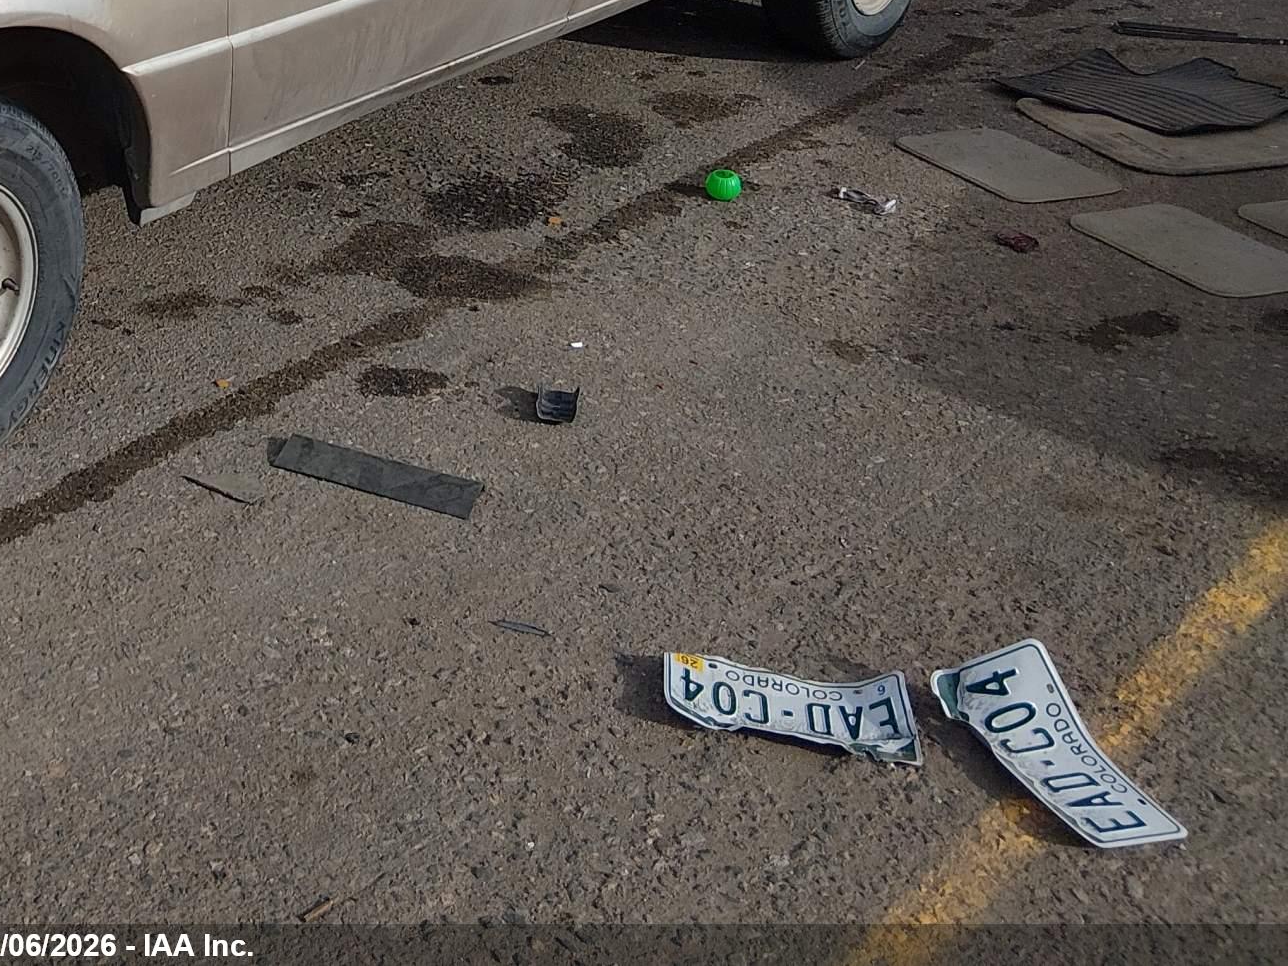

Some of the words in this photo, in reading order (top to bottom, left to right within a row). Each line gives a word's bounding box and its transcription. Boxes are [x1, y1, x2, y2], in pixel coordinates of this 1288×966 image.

[679, 654, 700, 670] 26
[724, 669, 843, 702] COLORADO
[680, 667, 902, 741] EAD-C04
[965, 667, 1148, 834] EAD-C04
[1045, 701, 1128, 795] COLORADO
